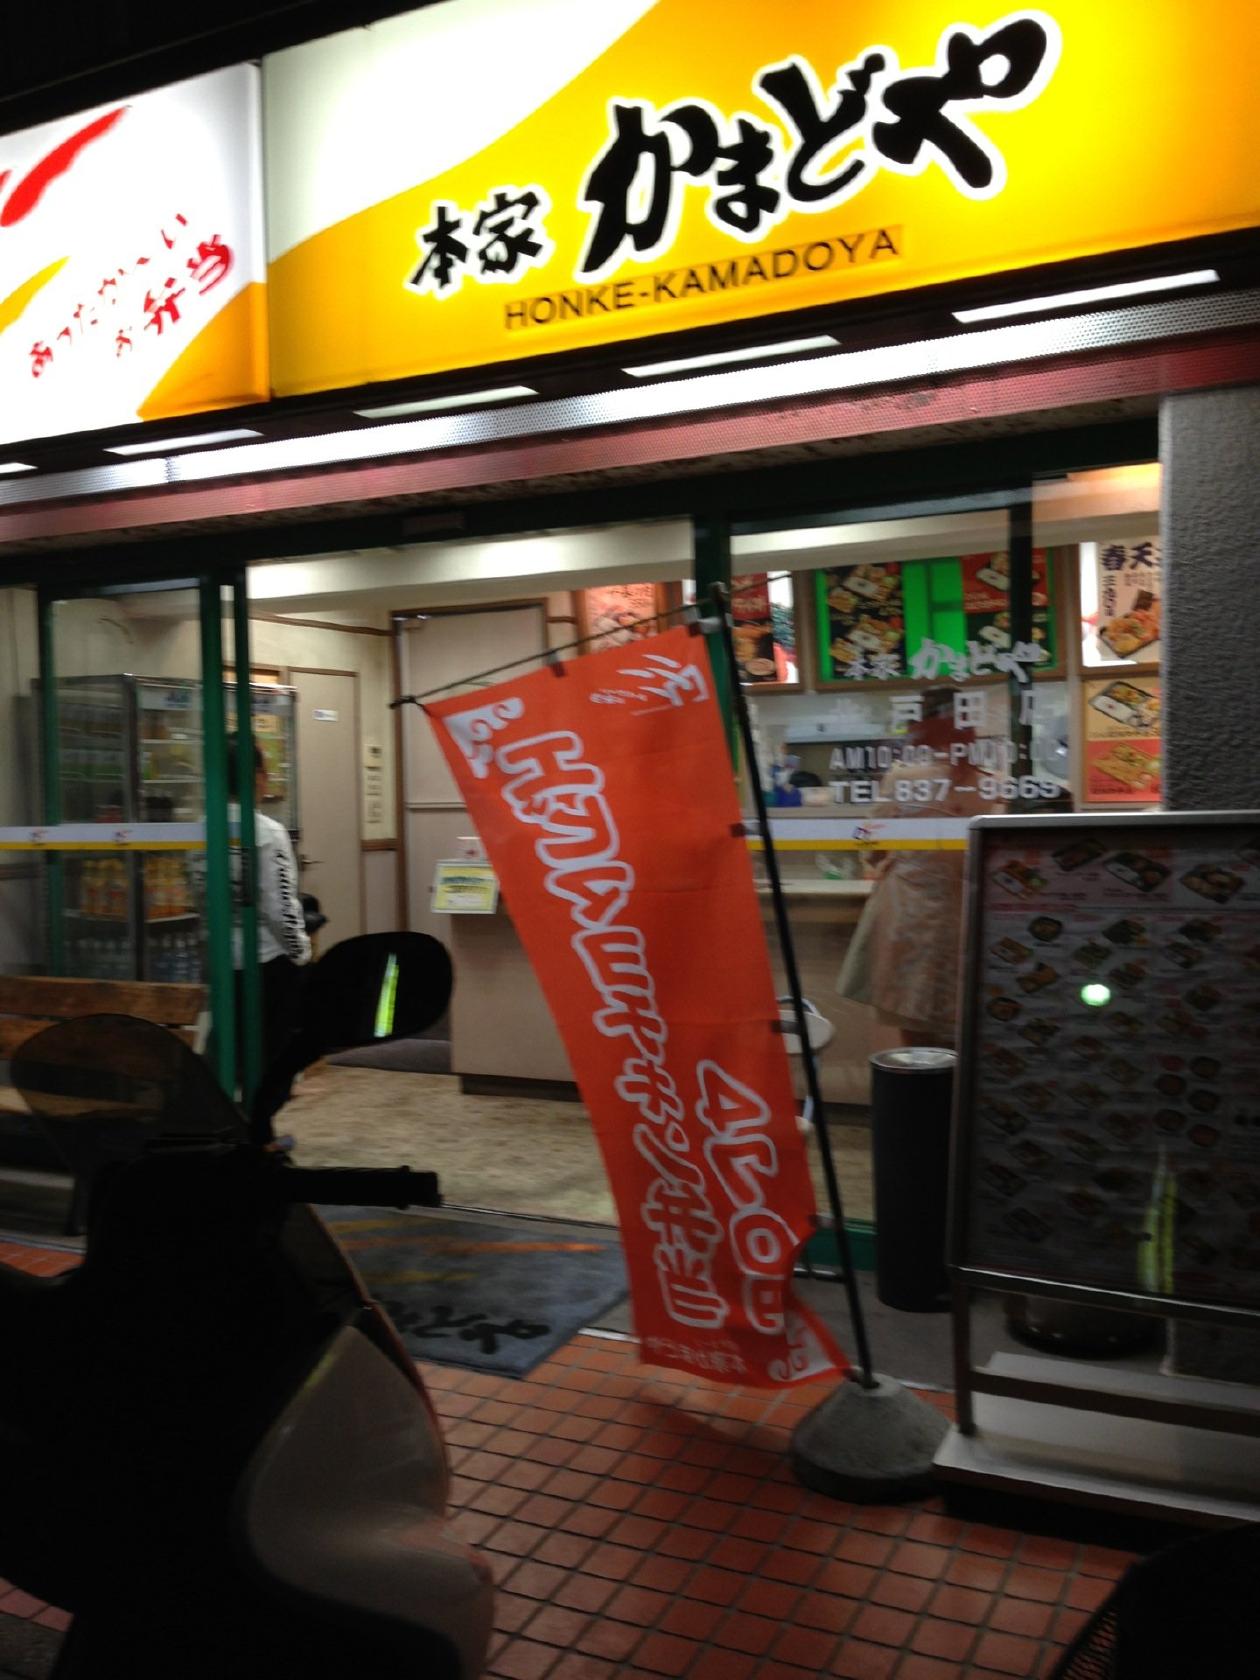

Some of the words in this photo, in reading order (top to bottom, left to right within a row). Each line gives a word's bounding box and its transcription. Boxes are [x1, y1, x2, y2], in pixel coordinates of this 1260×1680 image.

[410, 191, 545, 290] 本家
[581, 17, 1049, 274] かまどや
[505, 228, 899, 331] HONKE-KAMADOYA
[828, 779, 892, 804] TEL
